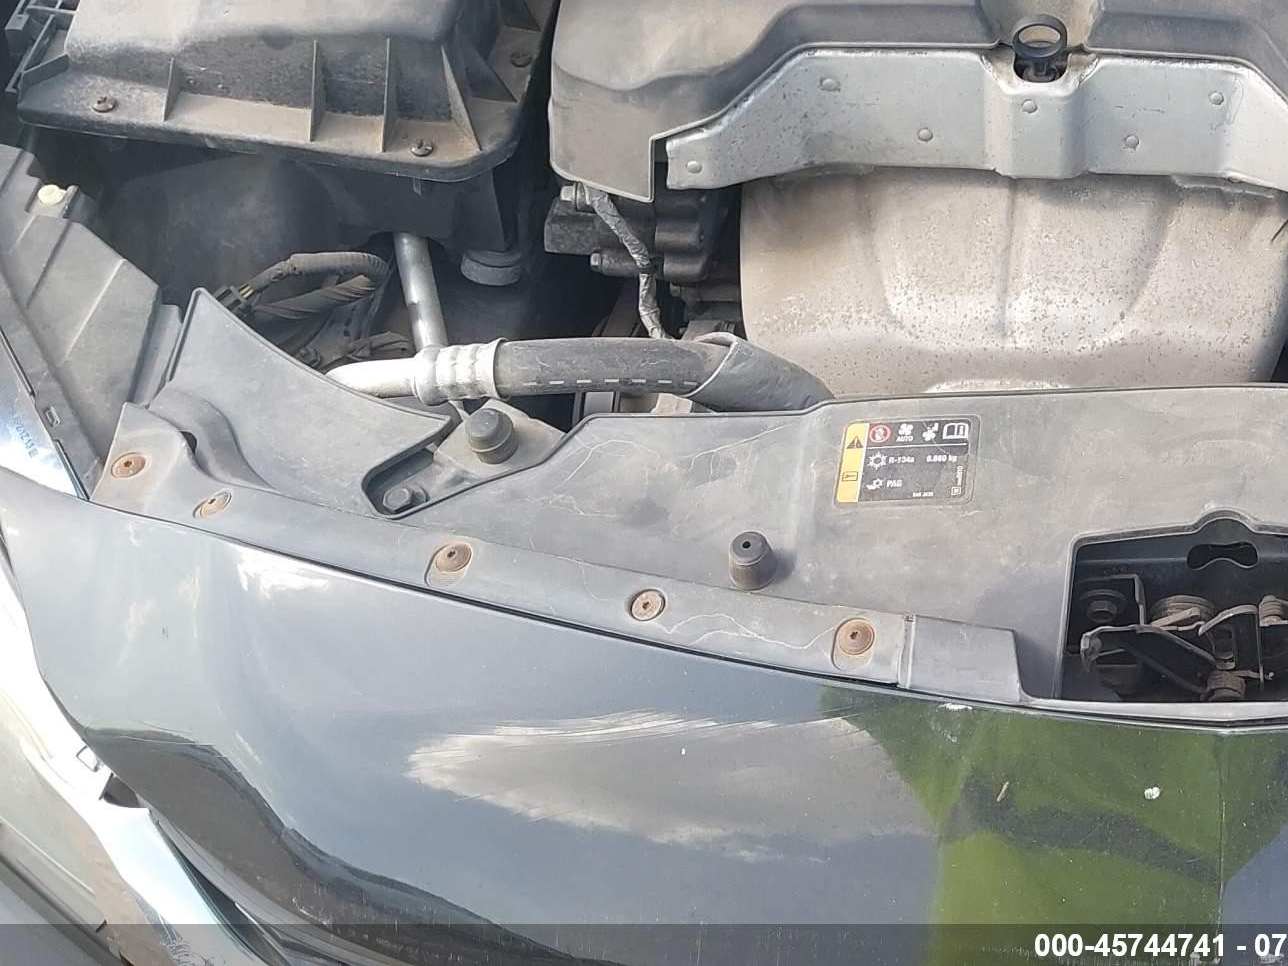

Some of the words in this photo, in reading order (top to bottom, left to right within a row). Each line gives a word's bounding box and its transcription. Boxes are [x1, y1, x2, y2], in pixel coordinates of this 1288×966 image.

[896, 435, 913, 443] AUTO
[888, 455, 914, 463] R-134a
[886, 479, 903, 488] PAG
